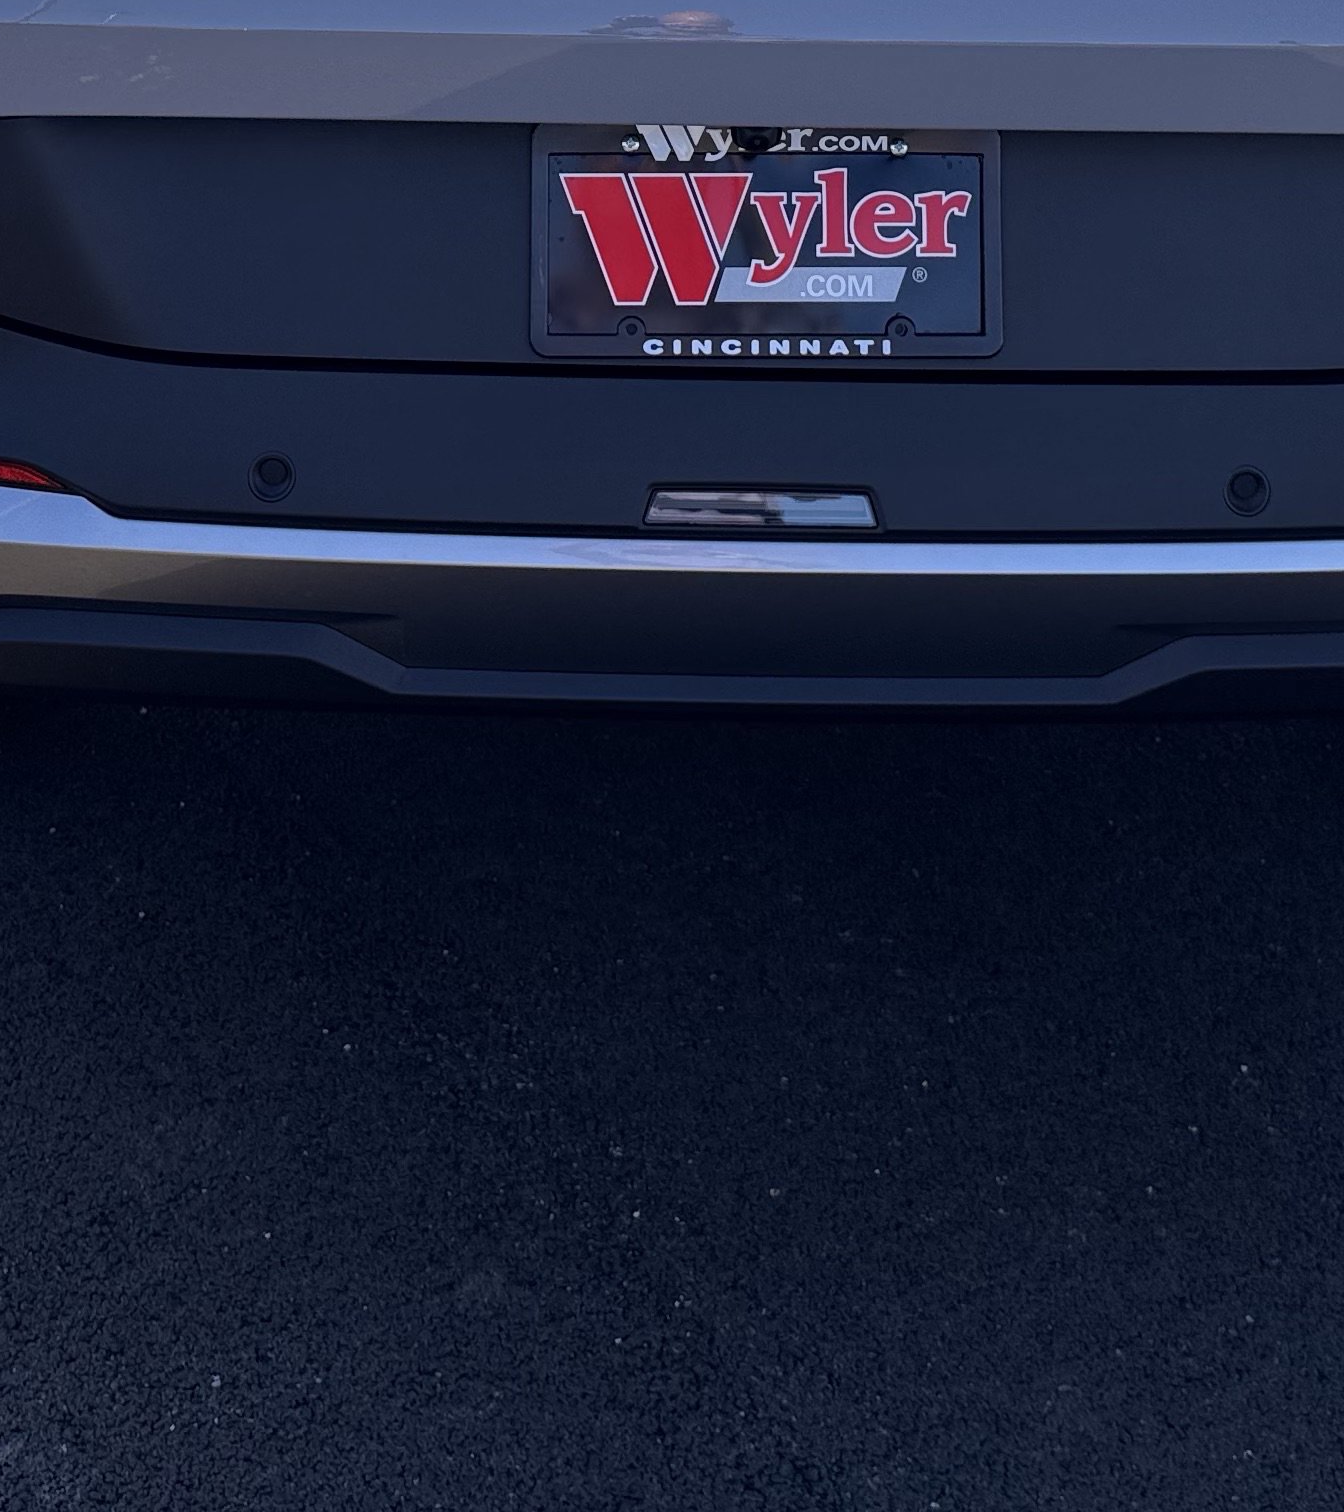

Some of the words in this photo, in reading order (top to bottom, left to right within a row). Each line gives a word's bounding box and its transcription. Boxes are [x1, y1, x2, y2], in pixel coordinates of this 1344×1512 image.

[635, 124, 888, 162] Wyr.COM
[559, 167, 972, 306] Wyler
[799, 274, 874, 299] .COM
[642, 338, 893, 356] CINCINNATI
